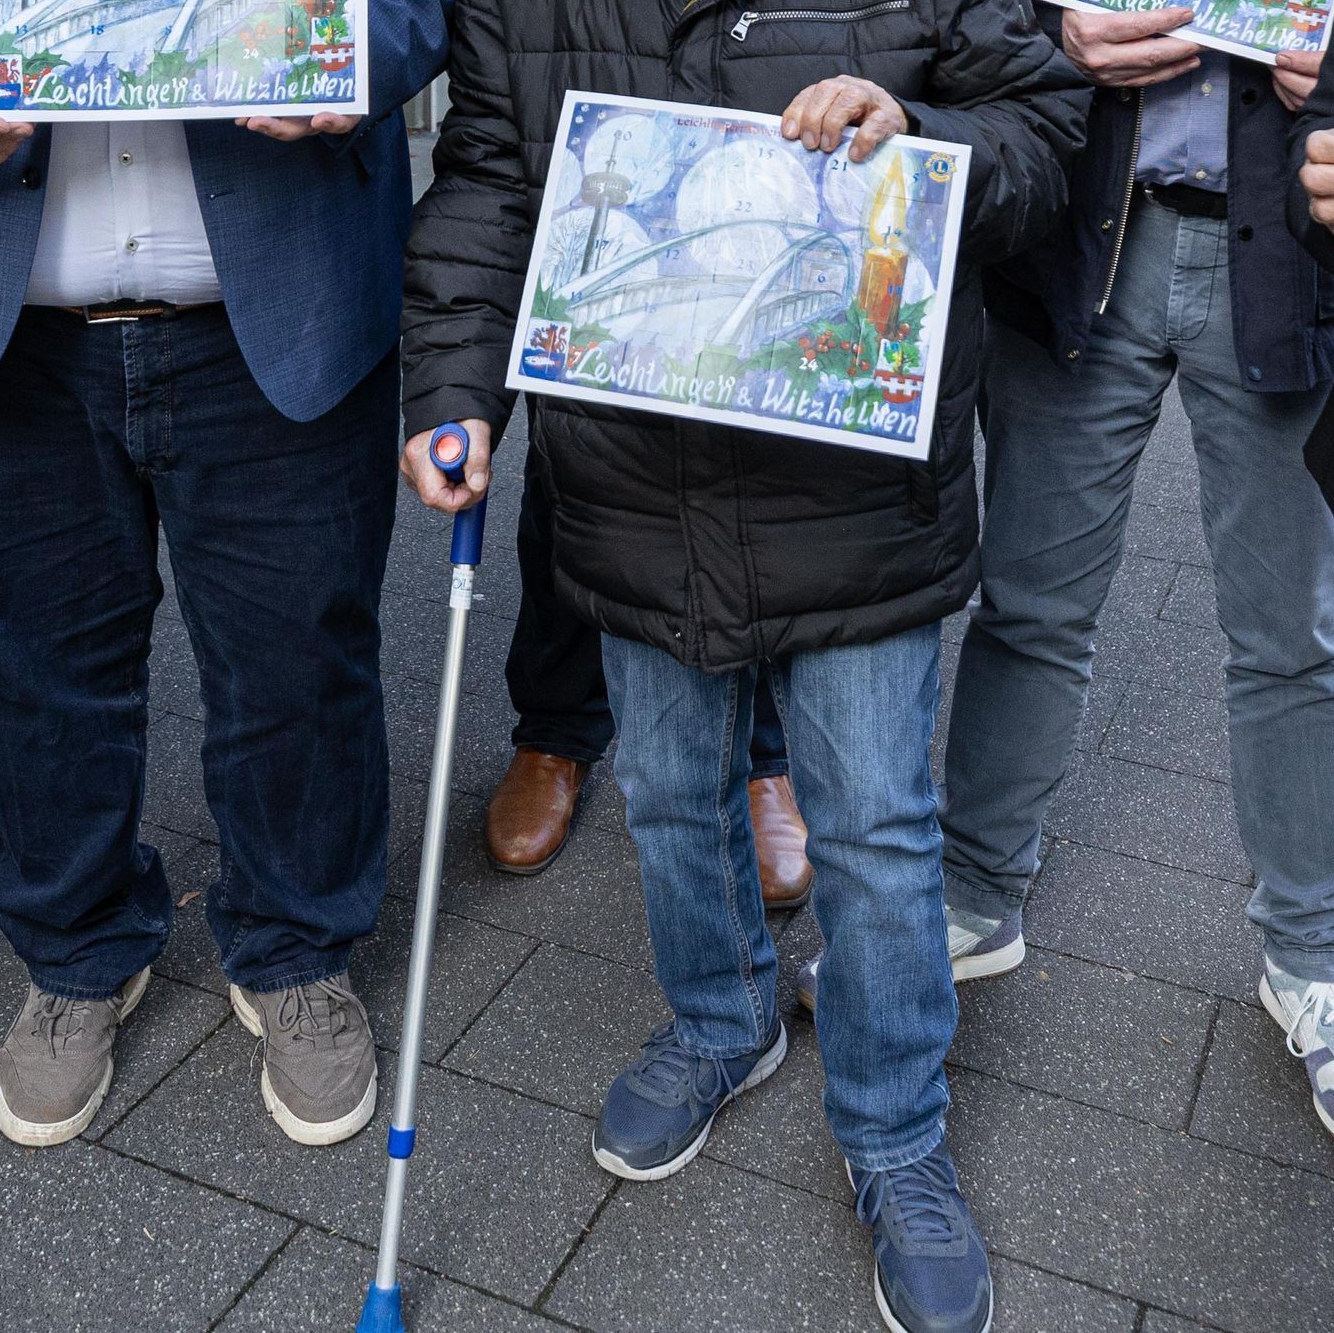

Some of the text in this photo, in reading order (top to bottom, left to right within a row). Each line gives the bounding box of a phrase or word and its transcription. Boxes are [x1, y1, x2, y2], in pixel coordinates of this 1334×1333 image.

[91, 25, 104, 35] 18
[242, 47, 260, 59] 24
[192, 82, 207, 102] &
[758, 148, 775, 159] 15
[831, 159, 847, 170] 21
[736, 202, 753, 213] 22
[886, 226, 903, 237] 14
[666, 249, 681, 260] 12
[798, 357, 819, 371] 24
[736, 385, 755, 407] &
